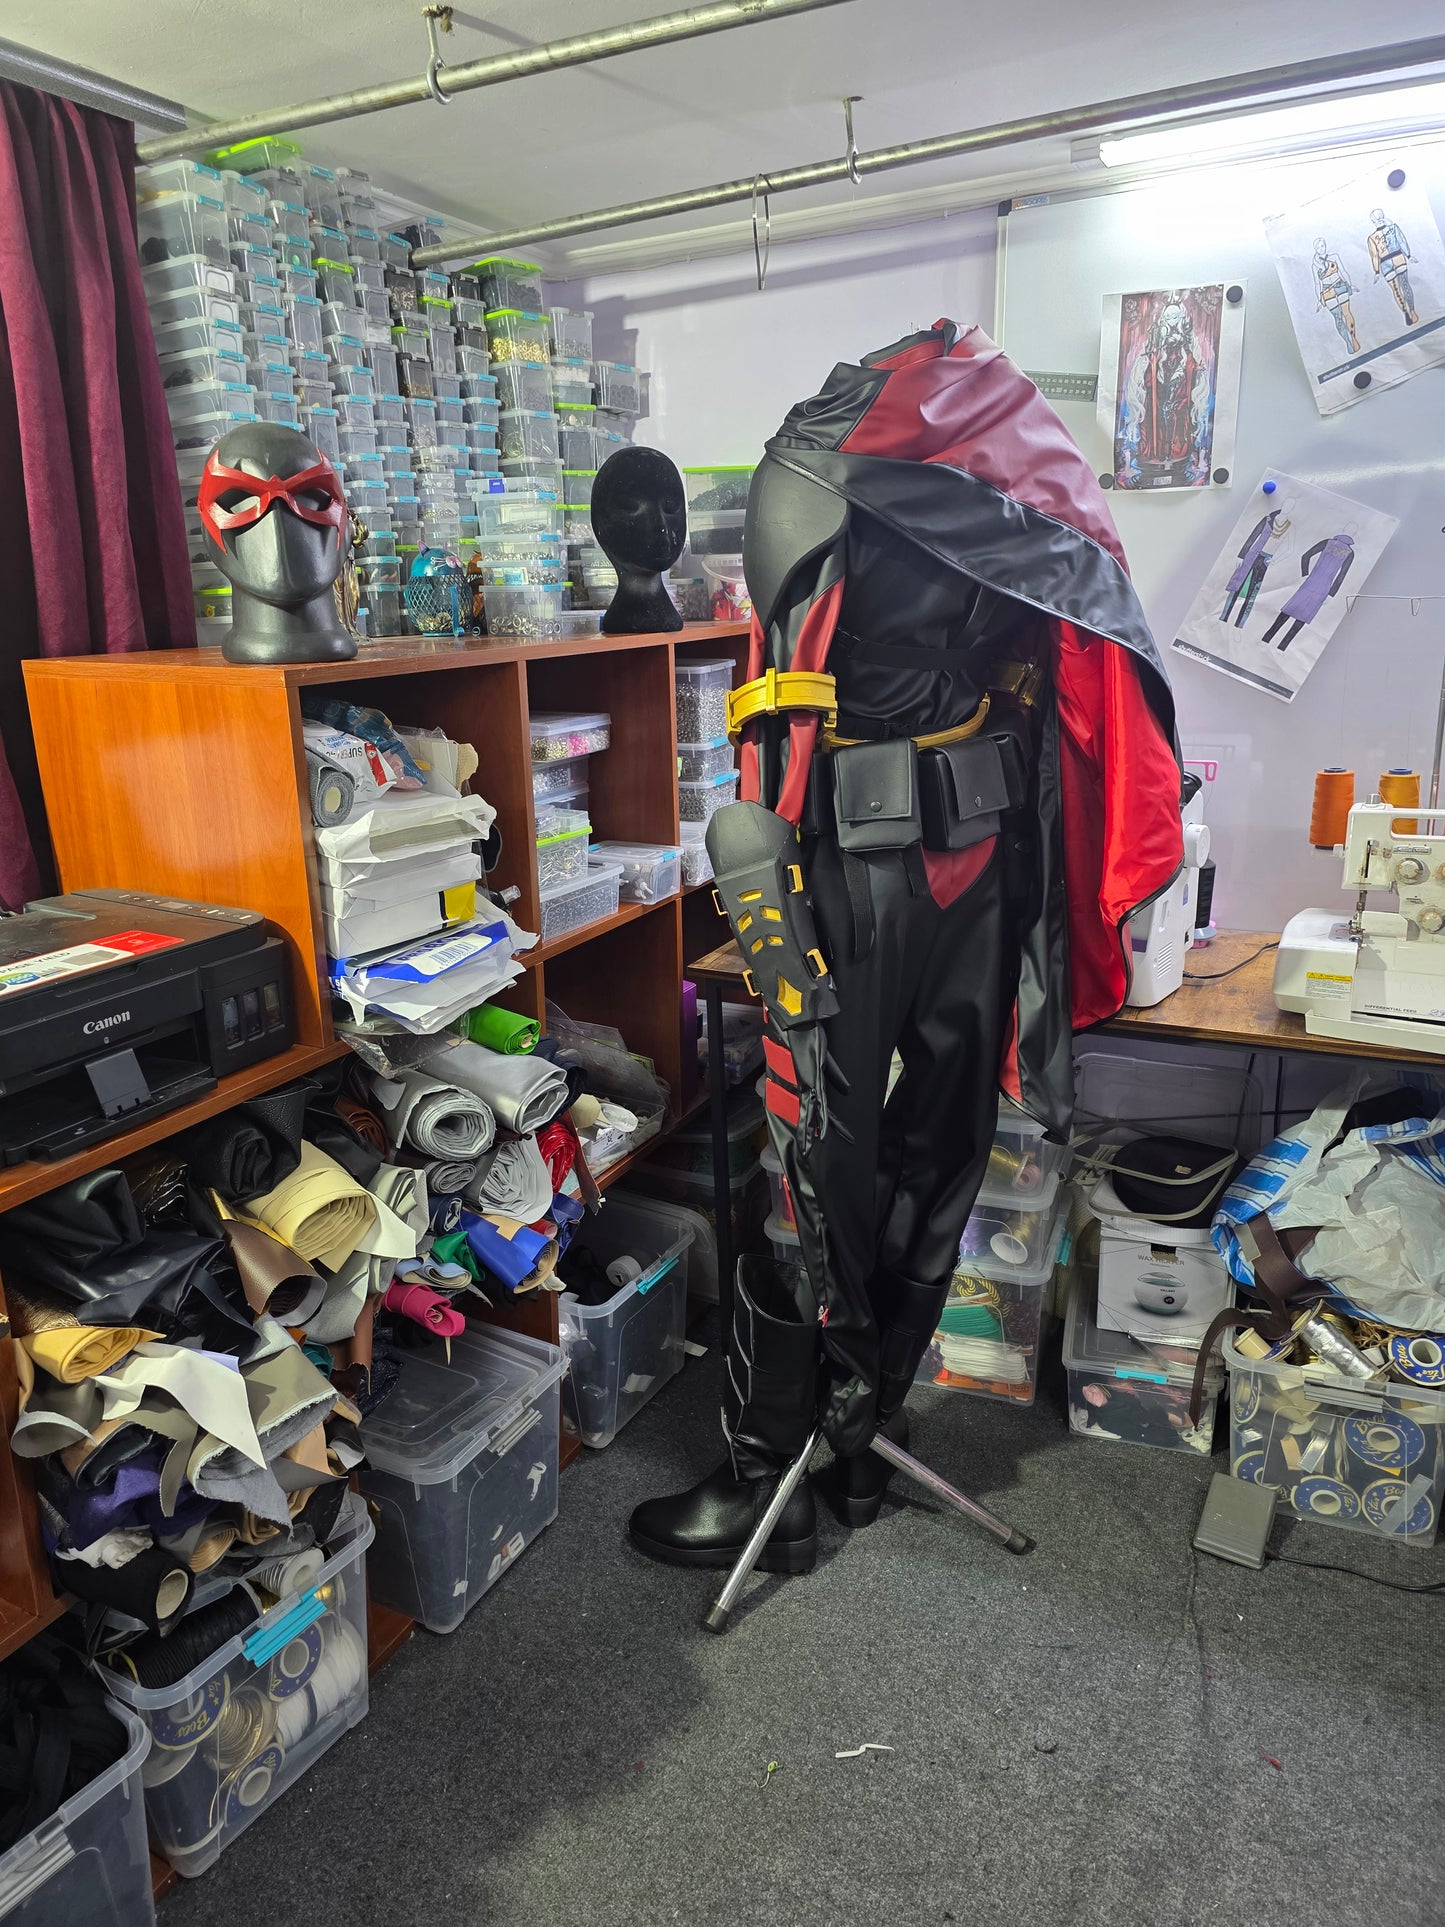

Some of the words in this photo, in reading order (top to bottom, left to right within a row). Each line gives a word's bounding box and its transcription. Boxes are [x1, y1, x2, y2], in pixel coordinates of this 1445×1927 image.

[1364, 1004, 1402, 1012] DIFFERENTIAL
[83, 1011, 131, 1035] Canon
[1137, 1254, 1154, 1262] WAX
